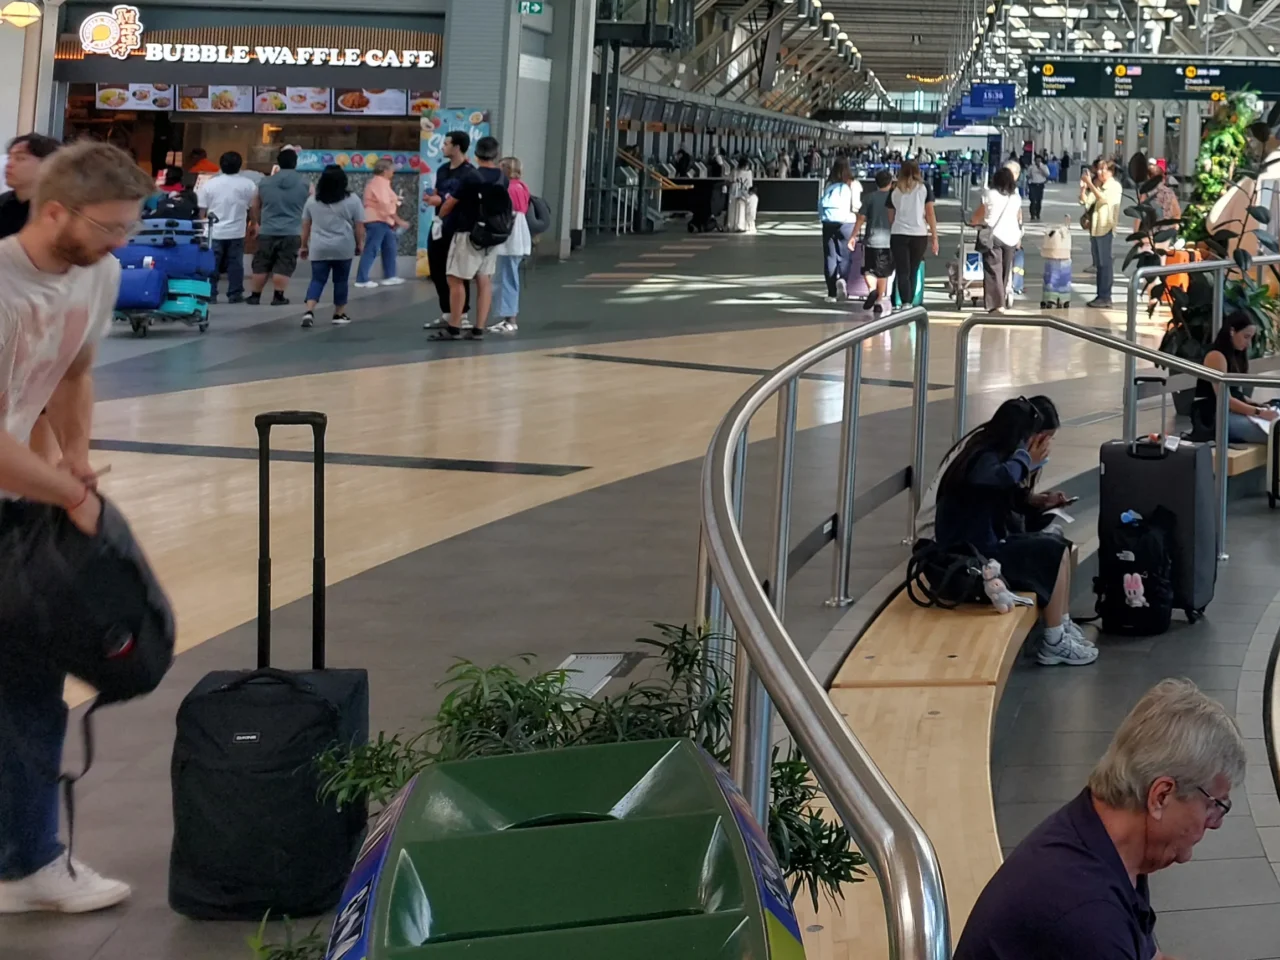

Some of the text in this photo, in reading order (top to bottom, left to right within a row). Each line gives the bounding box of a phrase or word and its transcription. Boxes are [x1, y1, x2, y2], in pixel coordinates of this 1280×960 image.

[145, 43, 435, 68] BUBBLE WAFFLE CAFE
